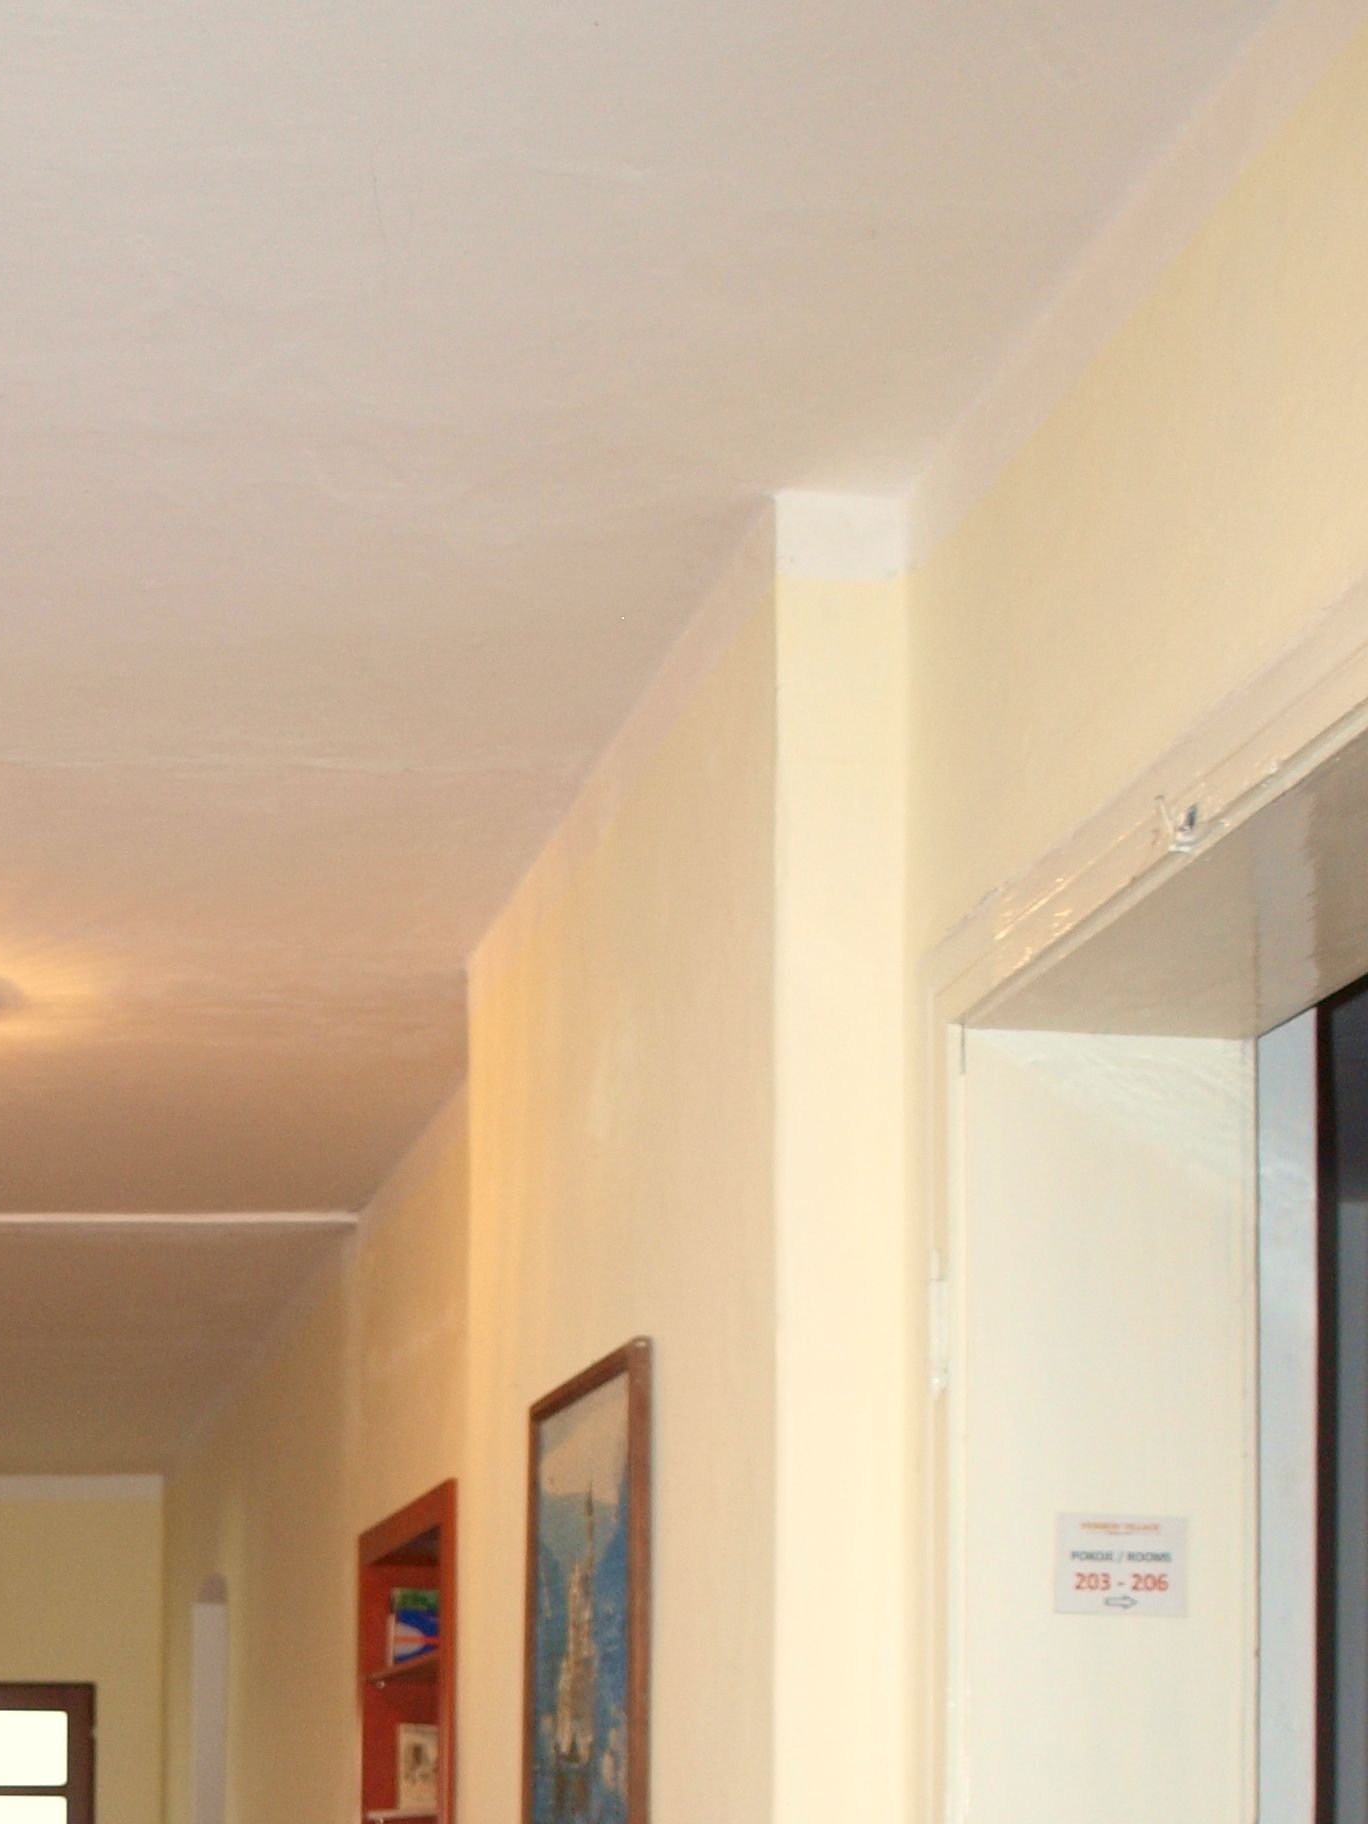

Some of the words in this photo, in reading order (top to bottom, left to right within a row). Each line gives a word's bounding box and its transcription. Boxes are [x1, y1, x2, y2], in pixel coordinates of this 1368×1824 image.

[1127, 1551, 1172, 1562] ROOMS
[1075, 1572, 1111, 1591] 203
[1132, 1573, 1169, 1592] 206
